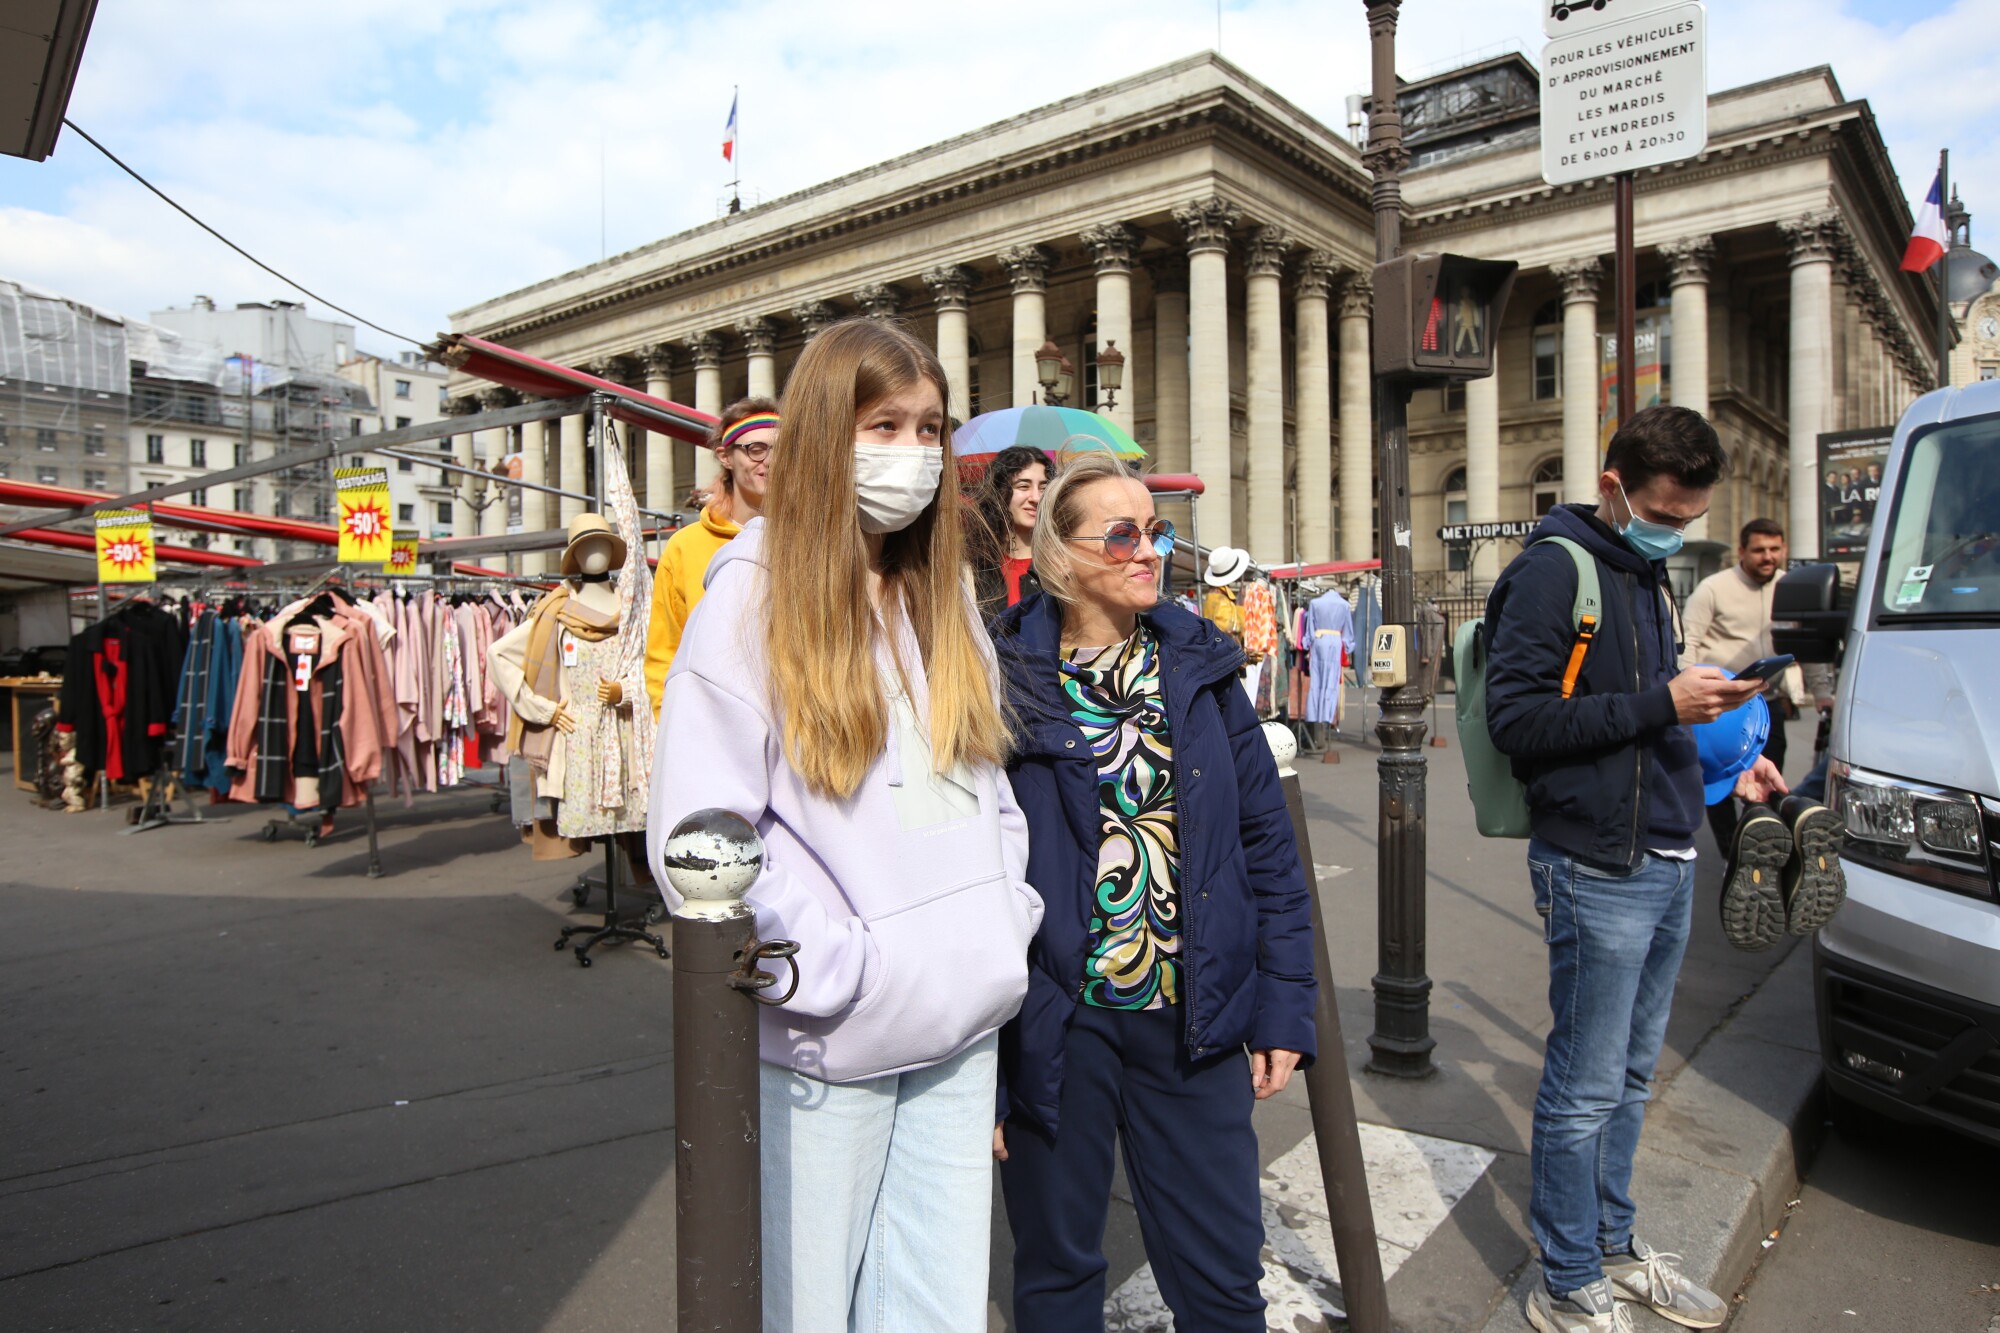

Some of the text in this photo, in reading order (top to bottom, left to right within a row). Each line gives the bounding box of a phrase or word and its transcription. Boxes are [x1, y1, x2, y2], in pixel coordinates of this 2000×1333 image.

[1550, 20, 1694, 67] POUR LES VÉHICULES
[1579, 70, 1663, 100] DU MARCHÉ
[1578, 92, 1665, 122] LES MARDIS
[1569, 111, 1675, 144] ET VENDREDIS
[1560, 153, 1578, 166] DE
[335, 471, 387, 490] DESTOCKAGE
[1841, 489, 1862, 503] LA
[96, 513, 150, 528] DESTOCKAGE
[345, 511, 381, 535] -50%
[1442, 522, 1540, 540] METROPOLIT
[105, 543, 142, 562] -50%
[1374, 660, 1391, 668] NEKO
